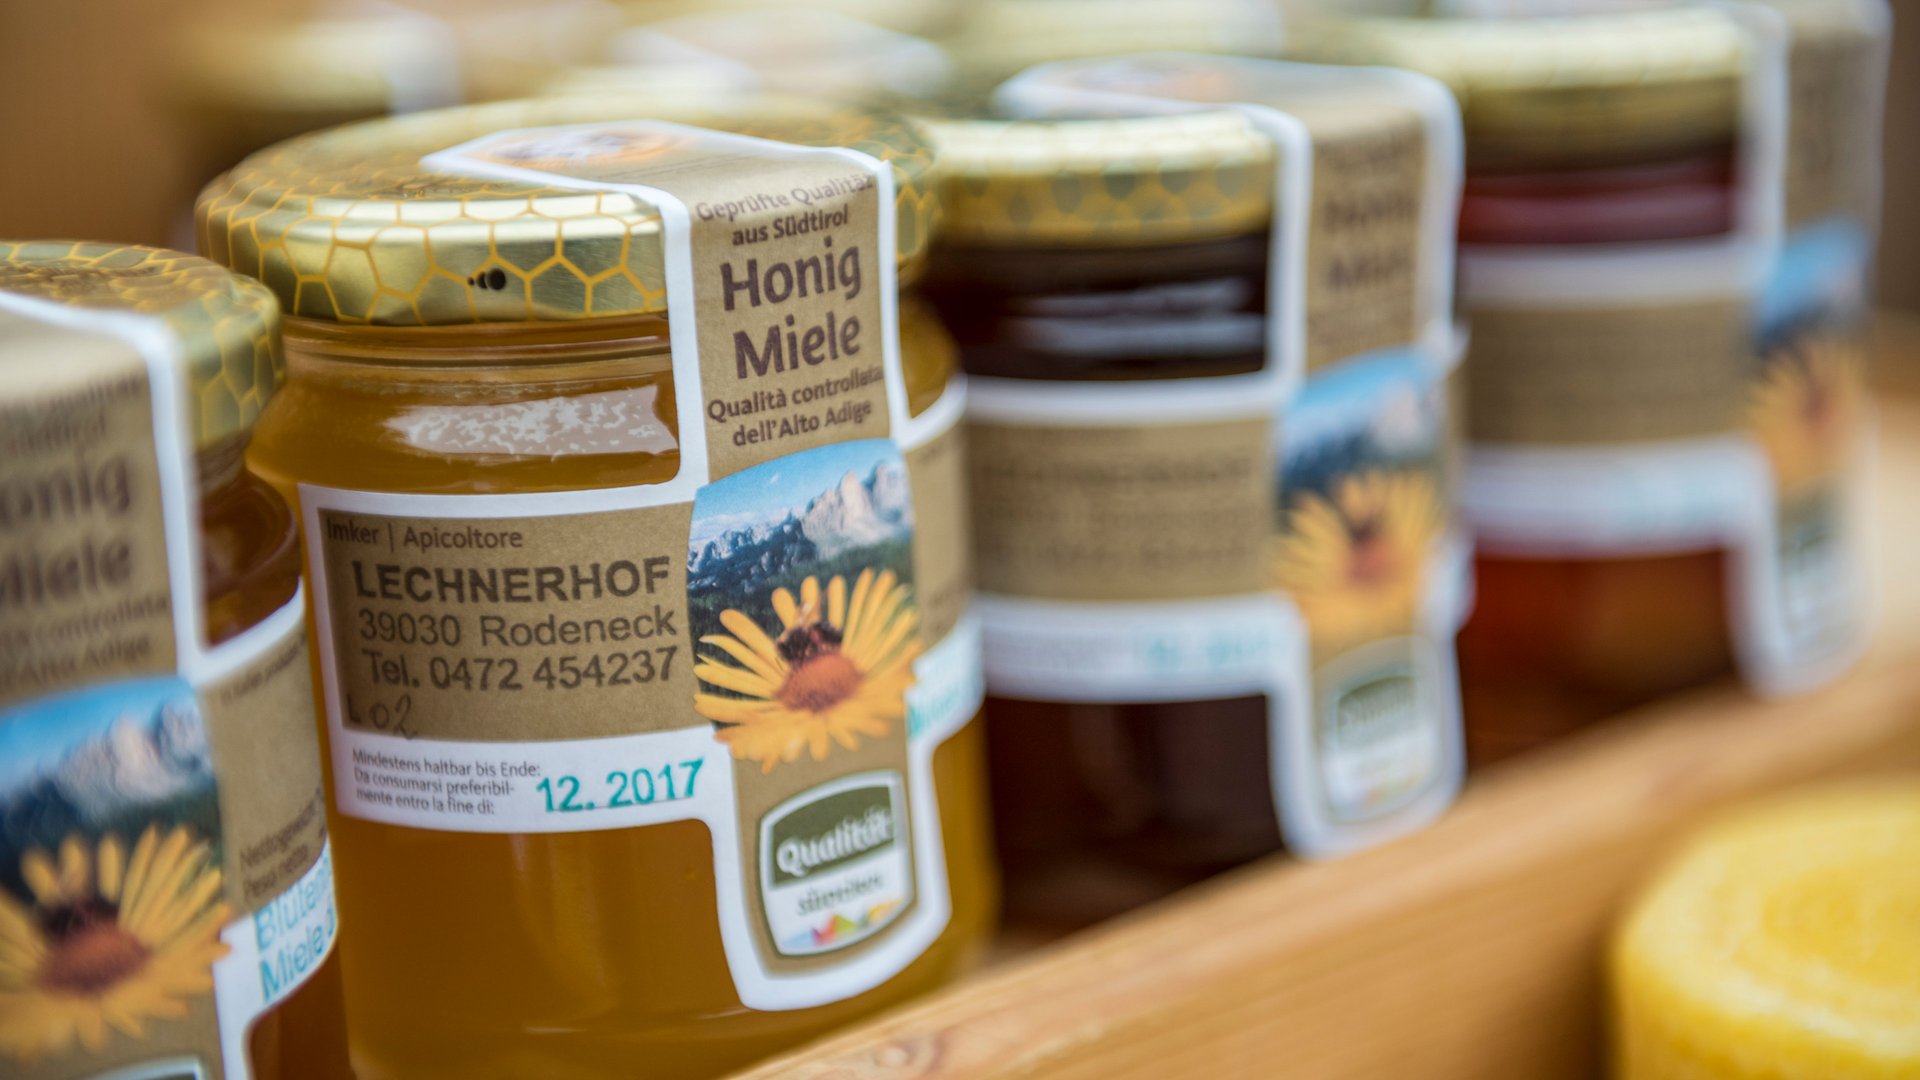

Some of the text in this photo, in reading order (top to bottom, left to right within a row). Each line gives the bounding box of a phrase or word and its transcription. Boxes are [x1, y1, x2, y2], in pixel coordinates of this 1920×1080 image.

[696, 193, 788, 222] Geprüfte
[732, 204, 849, 246] aus Südtirol
[720, 236, 861, 311] Honig
[733, 311, 861, 380] Miele
[707, 365, 884, 423] Qualità controllata
[824, 400, 872, 429] Adige
[327, 519, 379, 544] Imker
[403, 526, 523, 553] Apicoltore
[352, 555, 670, 604] LECHNERHOF
[359, 605, 678, 647] 39030 Rodeneck
[362, 645, 678, 691] Tel. 0472 454237
[353, 749, 541, 778] Mindestens haltbar bis Ende:
[354, 767, 515, 799] Da consumarsi preferibil-
[536, 757, 705, 813] 12. 2017
[356, 787, 495, 815] mente entro la fine di:
[776, 806, 892, 878] Qualität
[259, 922, 323, 1003] Miele
